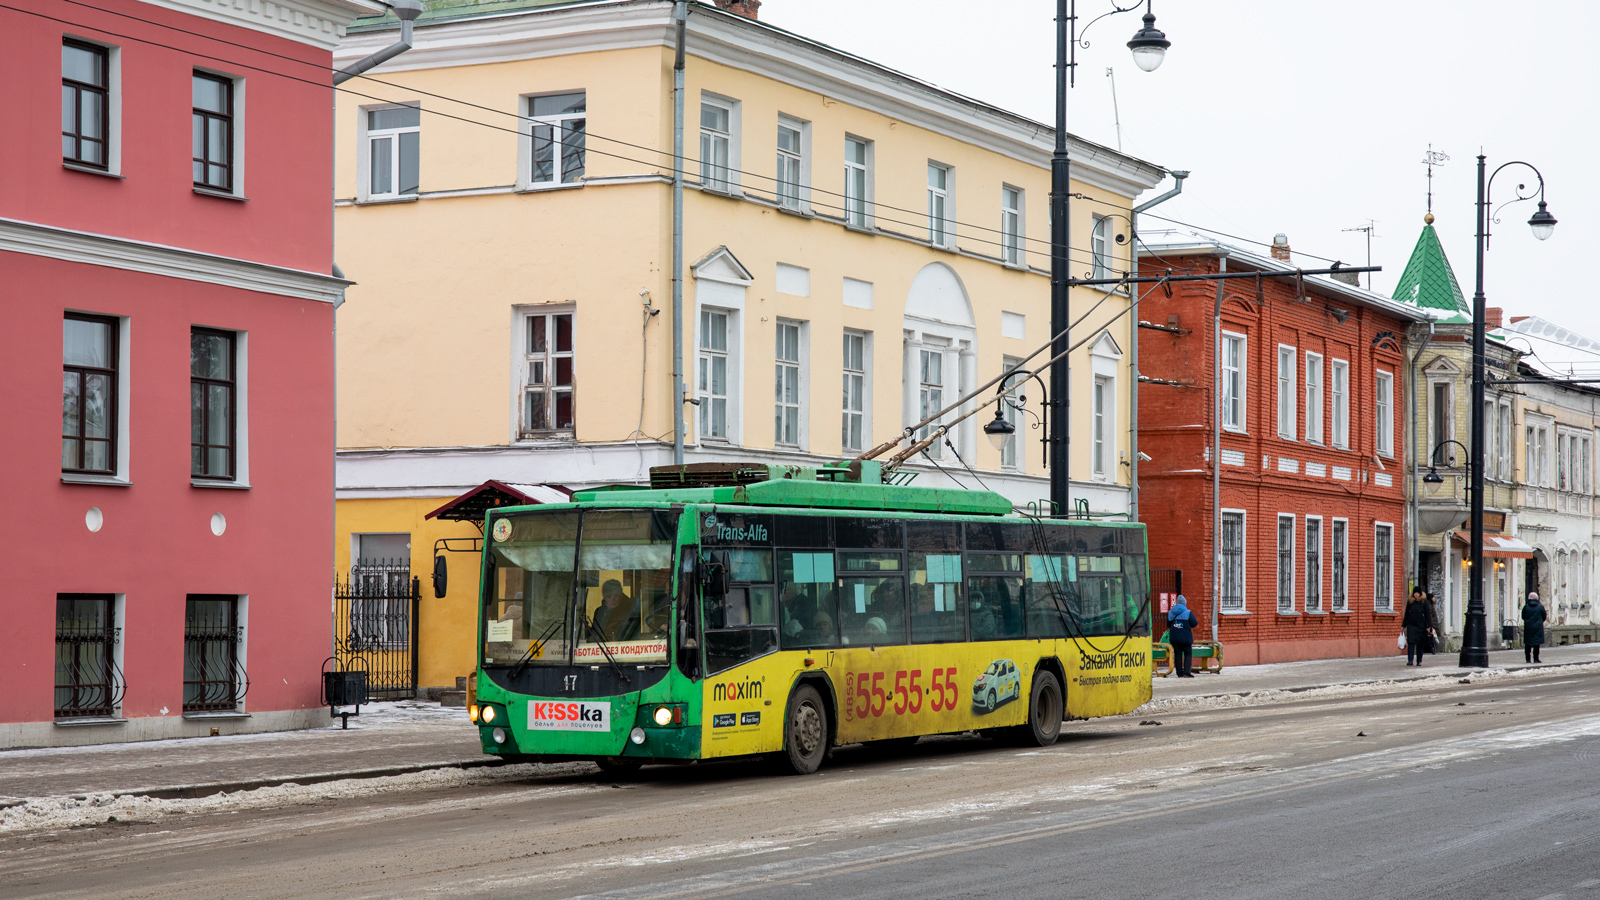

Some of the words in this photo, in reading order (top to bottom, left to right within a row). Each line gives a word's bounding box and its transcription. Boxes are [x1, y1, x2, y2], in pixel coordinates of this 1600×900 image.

[716, 523, 767, 541] Trans-Alfa
[574, 647, 604, 656] АБОТАЕТ
[606, 645, 619, 655] БЕЗ
[621, 644, 667, 655] КОНДУКТОРА
[826, 651, 834, 667] 17
[1079, 650, 1117, 670] Закажи
[1119, 652, 1145, 668] такси
[563, 675, 577, 691] 17
[1079, 675, 1101, 687] Быстрая
[845, 671, 854, 722] (4855)
